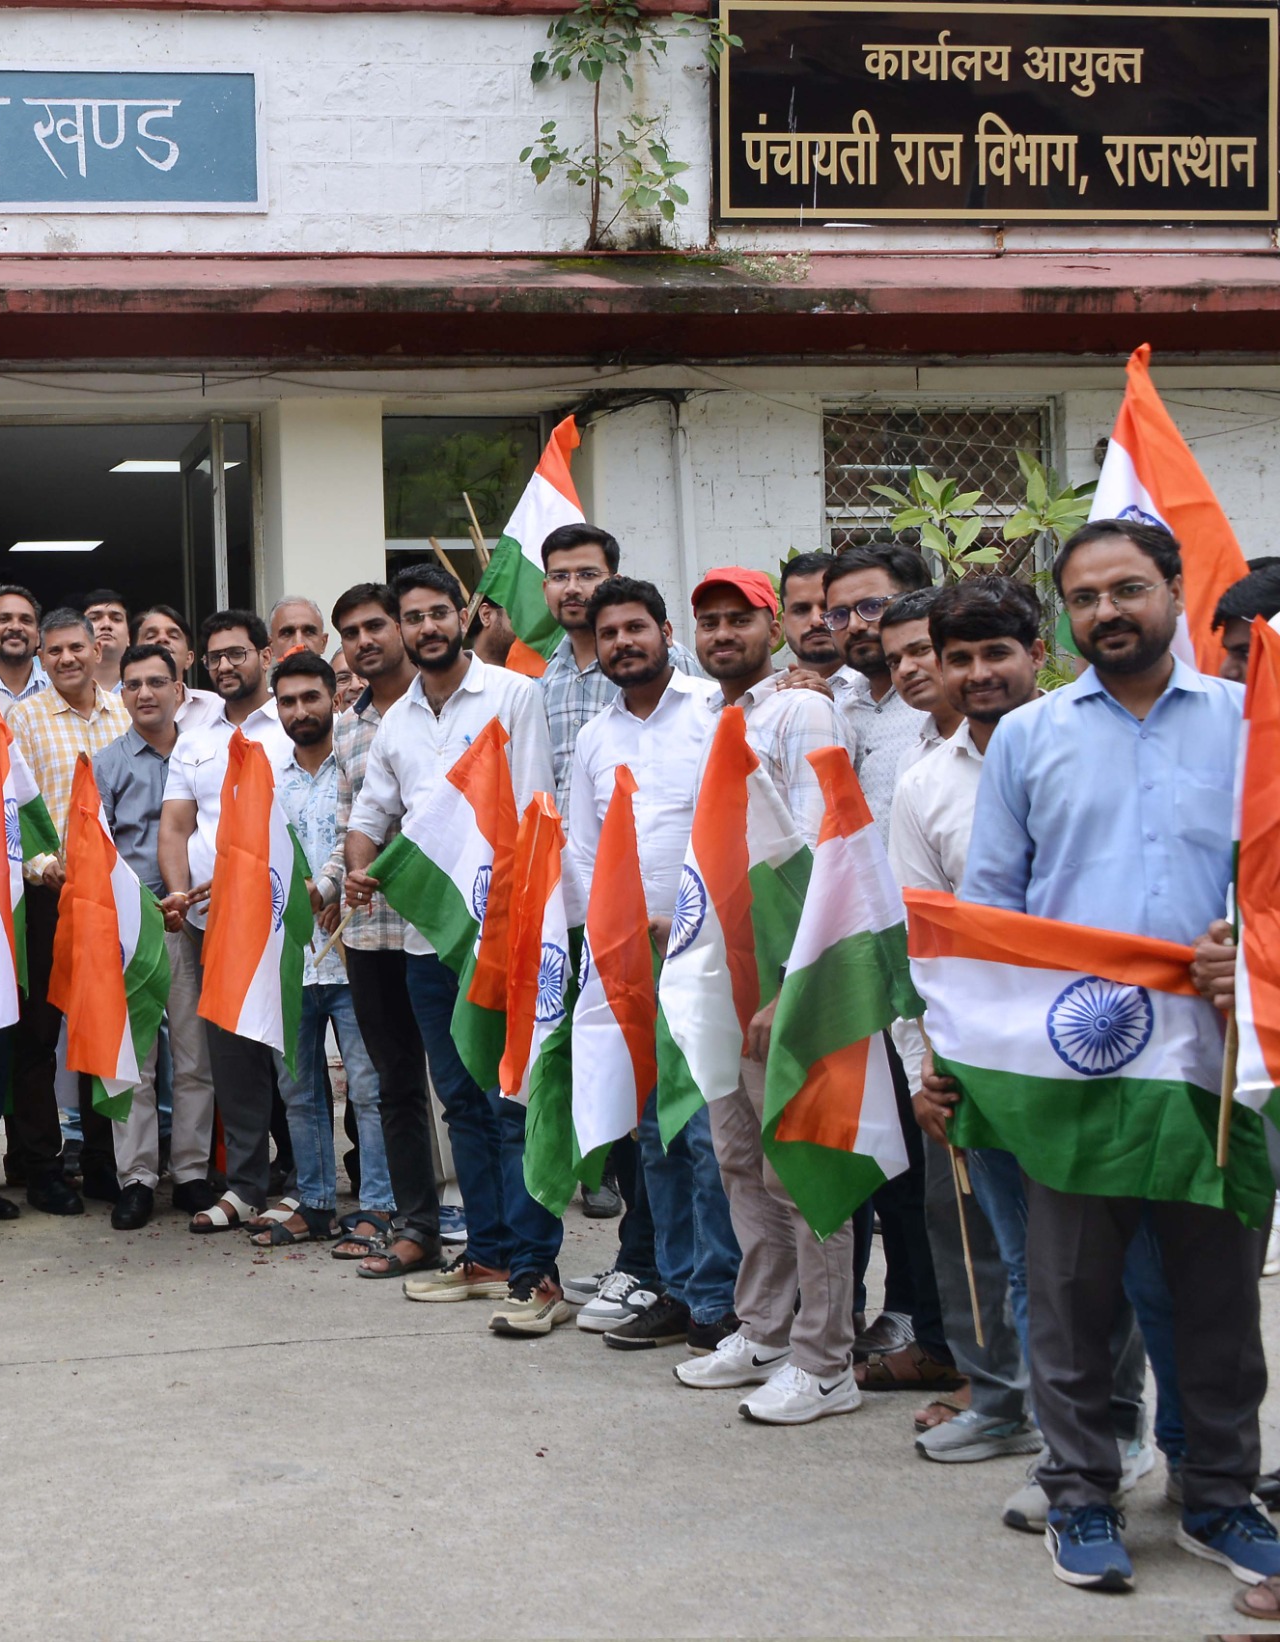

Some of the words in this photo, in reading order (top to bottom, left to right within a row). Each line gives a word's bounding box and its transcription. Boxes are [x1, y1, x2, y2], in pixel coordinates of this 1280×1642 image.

[862, 30, 1012, 82] कार्यालय
[1022, 45, 1144, 98] आयुक्त
[23, 97, 182, 179] खण्ड
[742, 109, 880, 186] पंचायती
[891, 133, 964, 186] राज
[974, 111, 1089, 195] विभाग,
[1102, 135, 1258, 188] राजस्थान
